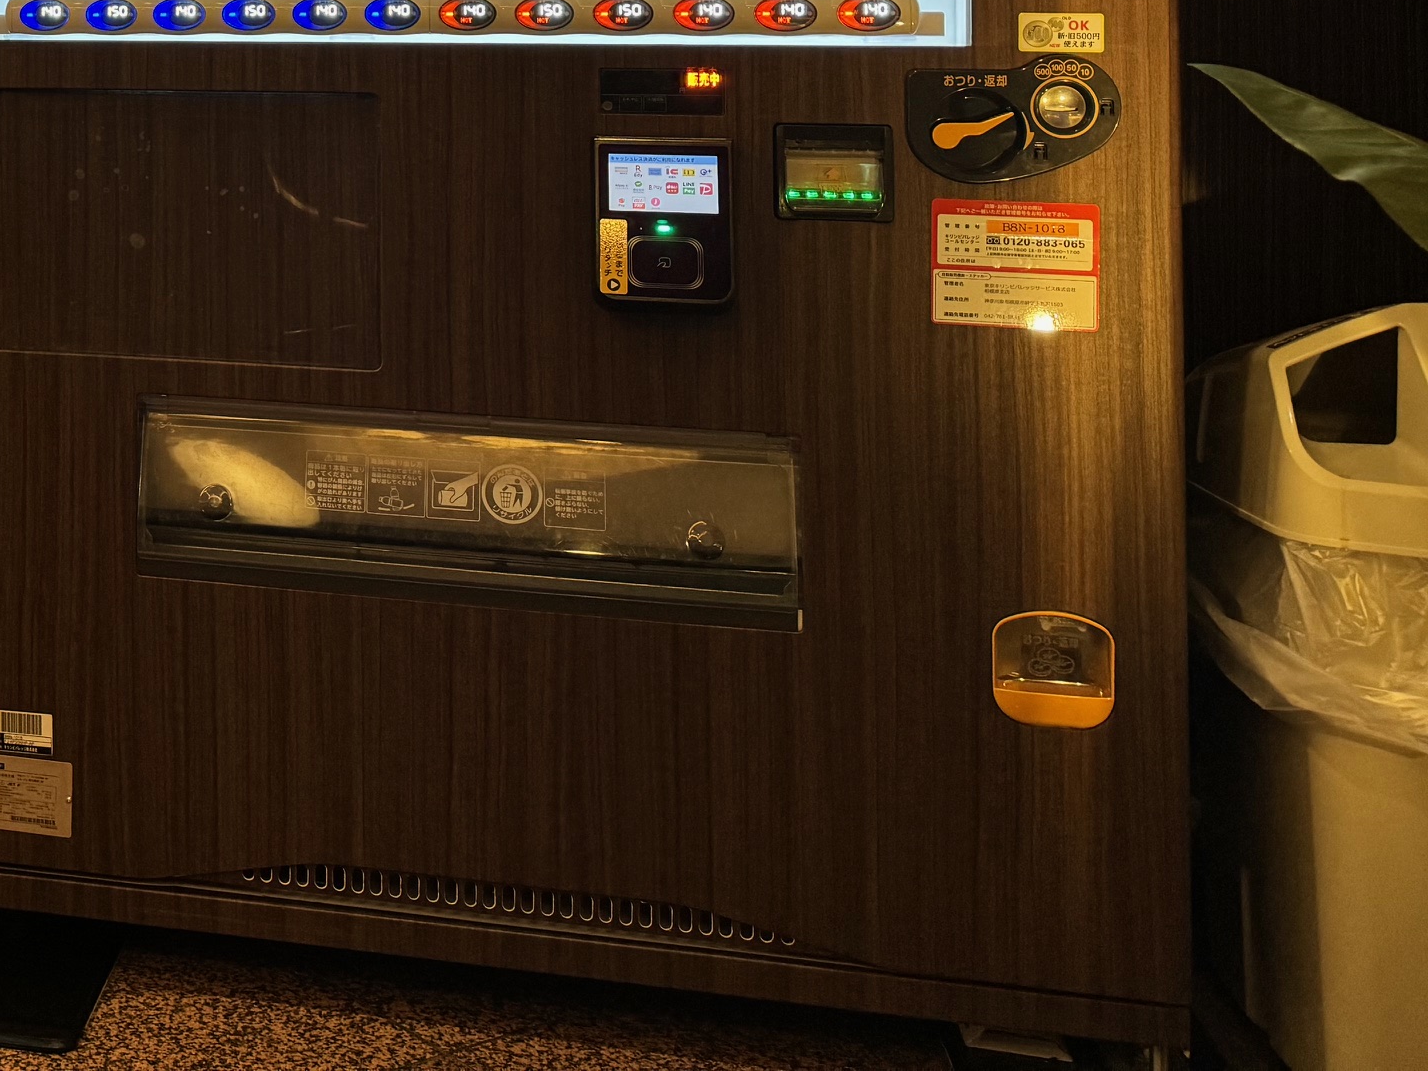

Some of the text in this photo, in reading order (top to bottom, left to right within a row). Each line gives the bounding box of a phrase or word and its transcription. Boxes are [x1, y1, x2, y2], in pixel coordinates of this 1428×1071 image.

[1069, 20, 1090, 31] OK
[1057, 32, 1101, 41] 新・旧500円
[1063, 40, 1095, 48] 使えます
[1036, 67, 1050, 76] 500
[1051, 63, 1063, 72] 100
[687, 71, 720, 87] 販売中
[943, 74, 1007, 87] おつり・返却
[1003, 237, 1086, 249] 0120-883-065
